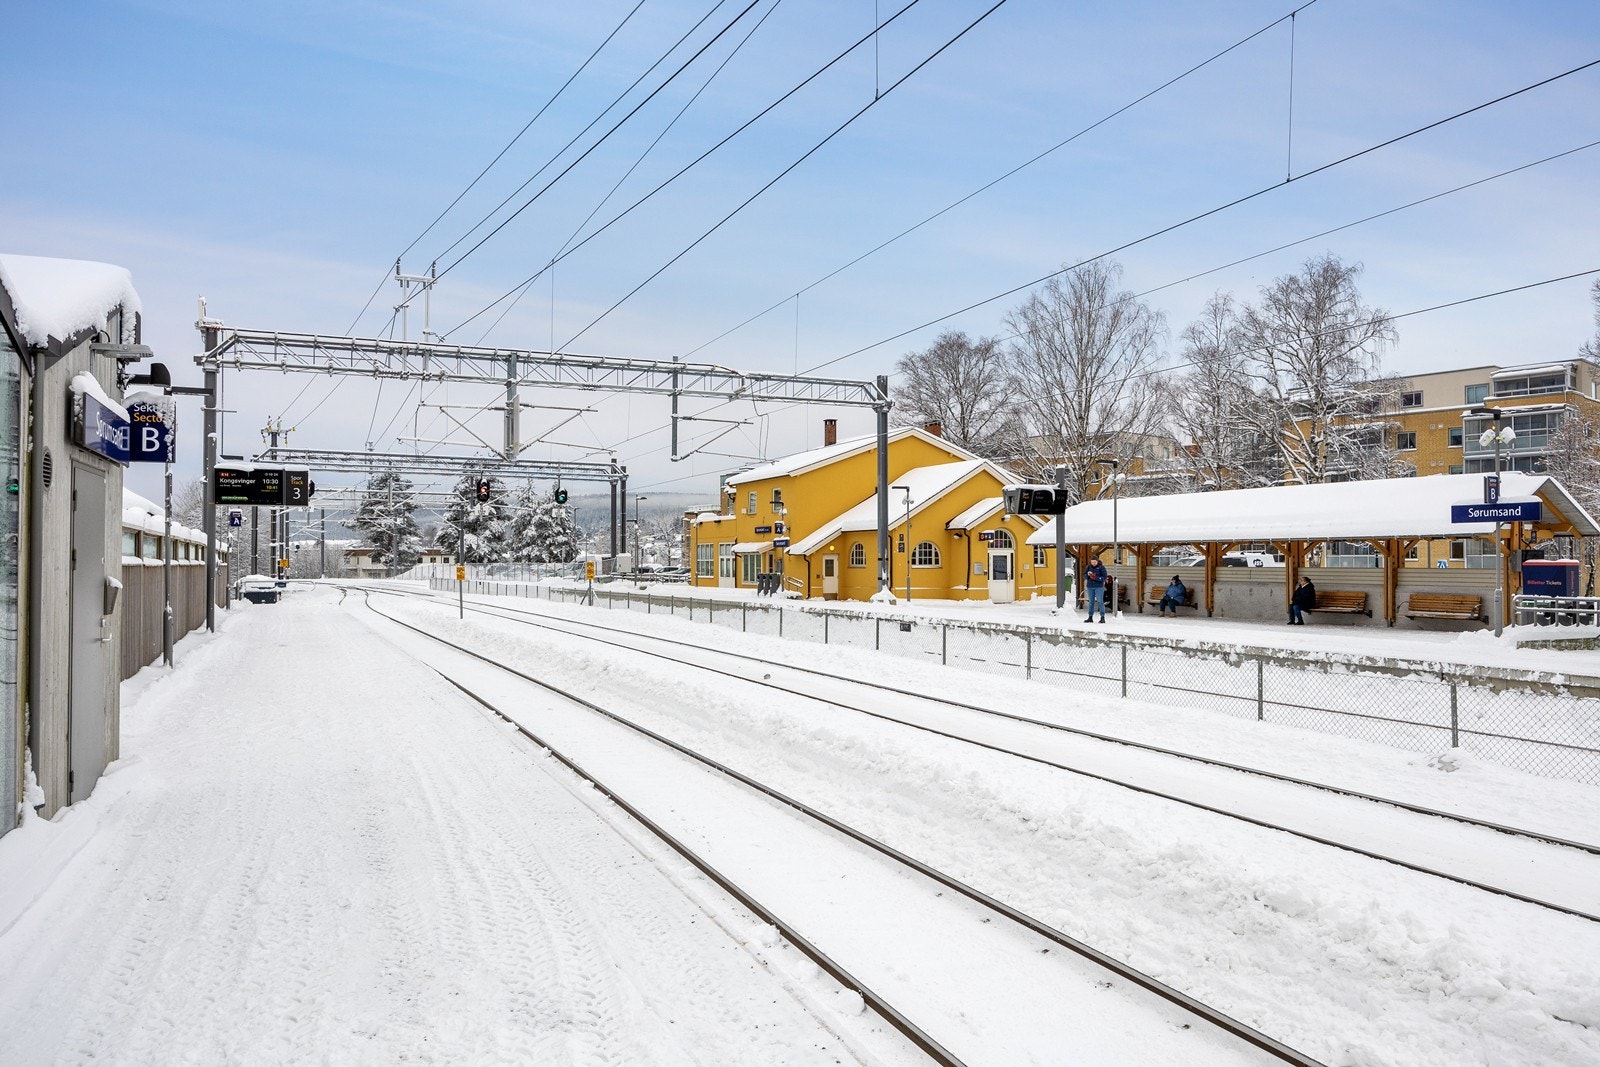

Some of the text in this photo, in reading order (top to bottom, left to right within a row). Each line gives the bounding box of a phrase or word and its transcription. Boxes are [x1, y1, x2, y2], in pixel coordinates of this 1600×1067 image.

[133, 403, 158, 412] Sekt
[133, 412, 163, 422] Secto
[141, 427, 160, 452] B
[292, 487, 301, 500] 3
[1490, 488, 1496, 499] B
[1468, 505, 1521, 518] Sørumsand
